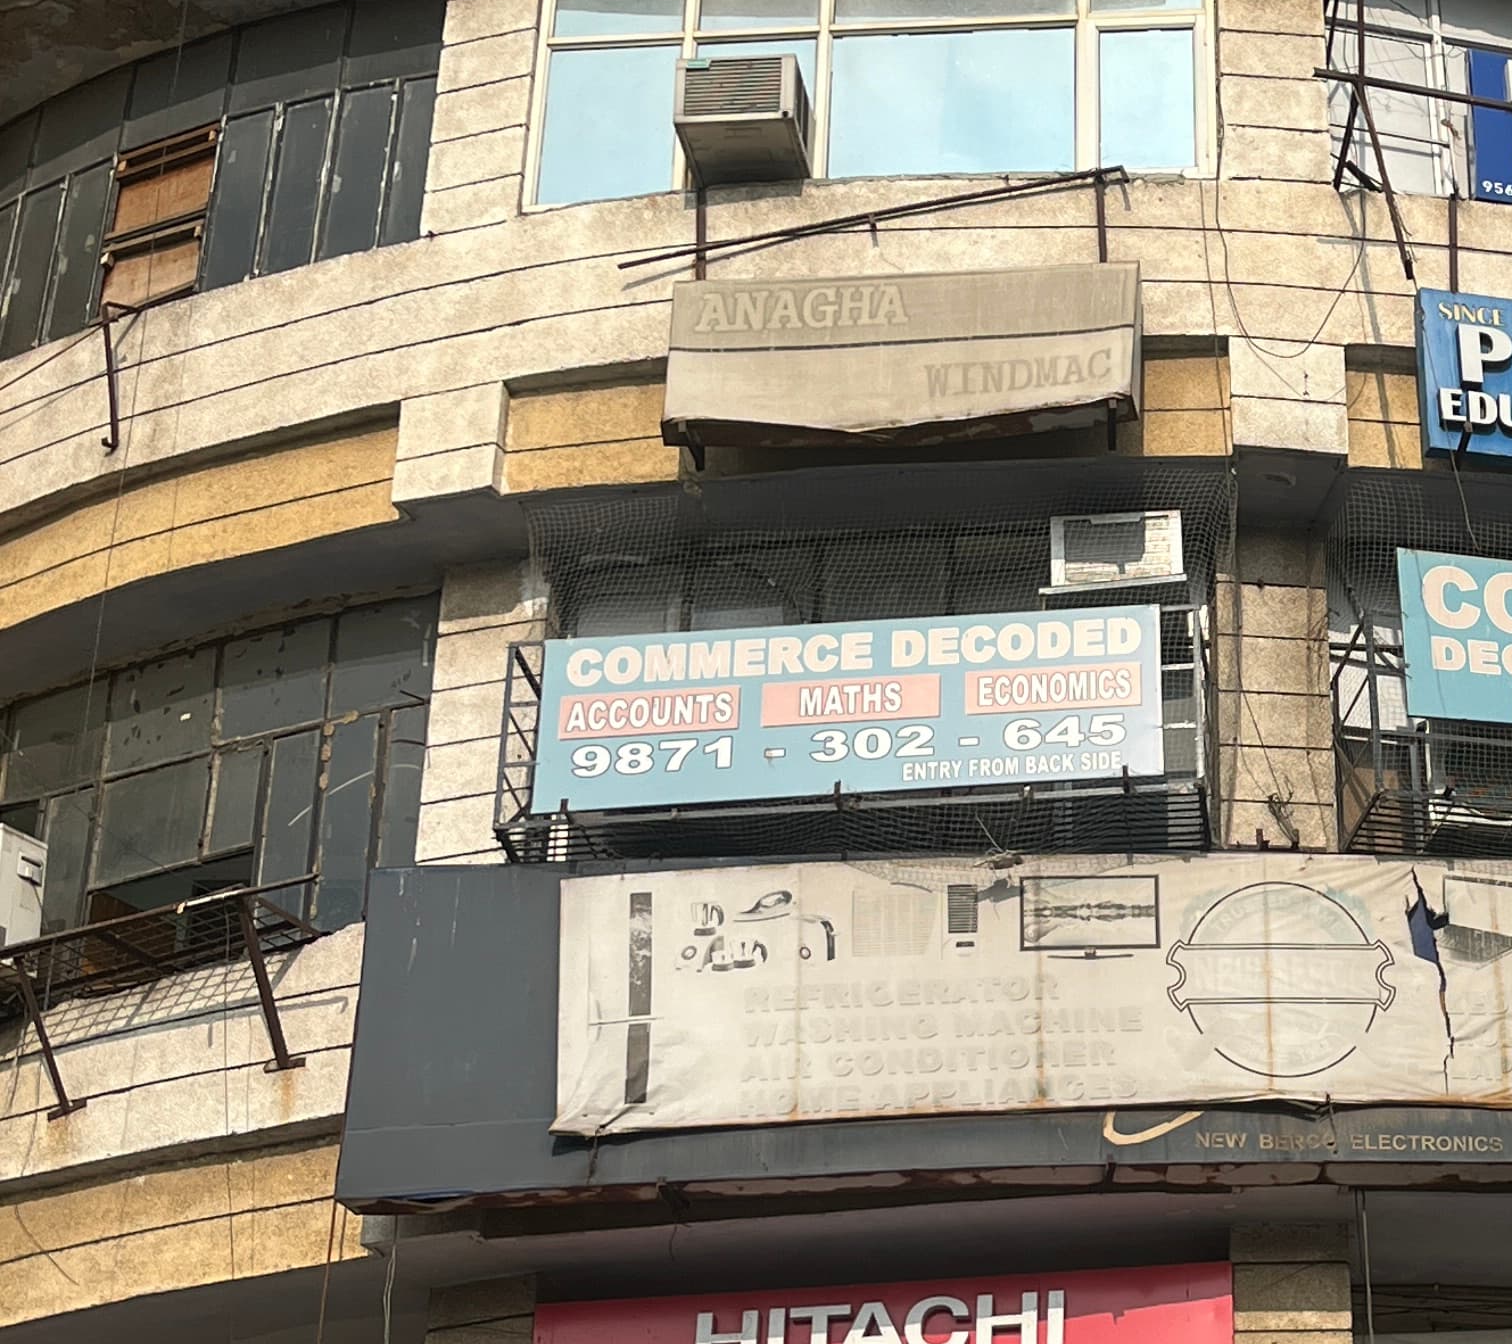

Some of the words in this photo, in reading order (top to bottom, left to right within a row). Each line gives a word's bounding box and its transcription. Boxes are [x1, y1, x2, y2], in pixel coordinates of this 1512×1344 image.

[695, 285, 910, 333] ANAGHA
[1438, 301, 1505, 327] SINCE
[924, 348, 1112, 397] WINDMAC
[567, 632, 873, 687] COMMERCE
[890, 617, 1142, 666] DECODED
[565, 691, 734, 733] ACCOUNTS
[799, 682, 903, 718] MATHS
[977, 668, 1132, 707] ECONOMICS
[571, 736, 734, 779] 9871
[810, 725, 935, 763] 302
[1003, 714, 1127, 751] 645
[902, 760, 963, 783] ENTRY
[969, 756, 1020, 777] FROM
[1025, 753, 1075, 774] BACK
[1080, 750, 1122, 771] SIDE
[1196, 1132, 1247, 1149] NEW
[1352, 1134, 1504, 1153] ELECTRONICS
